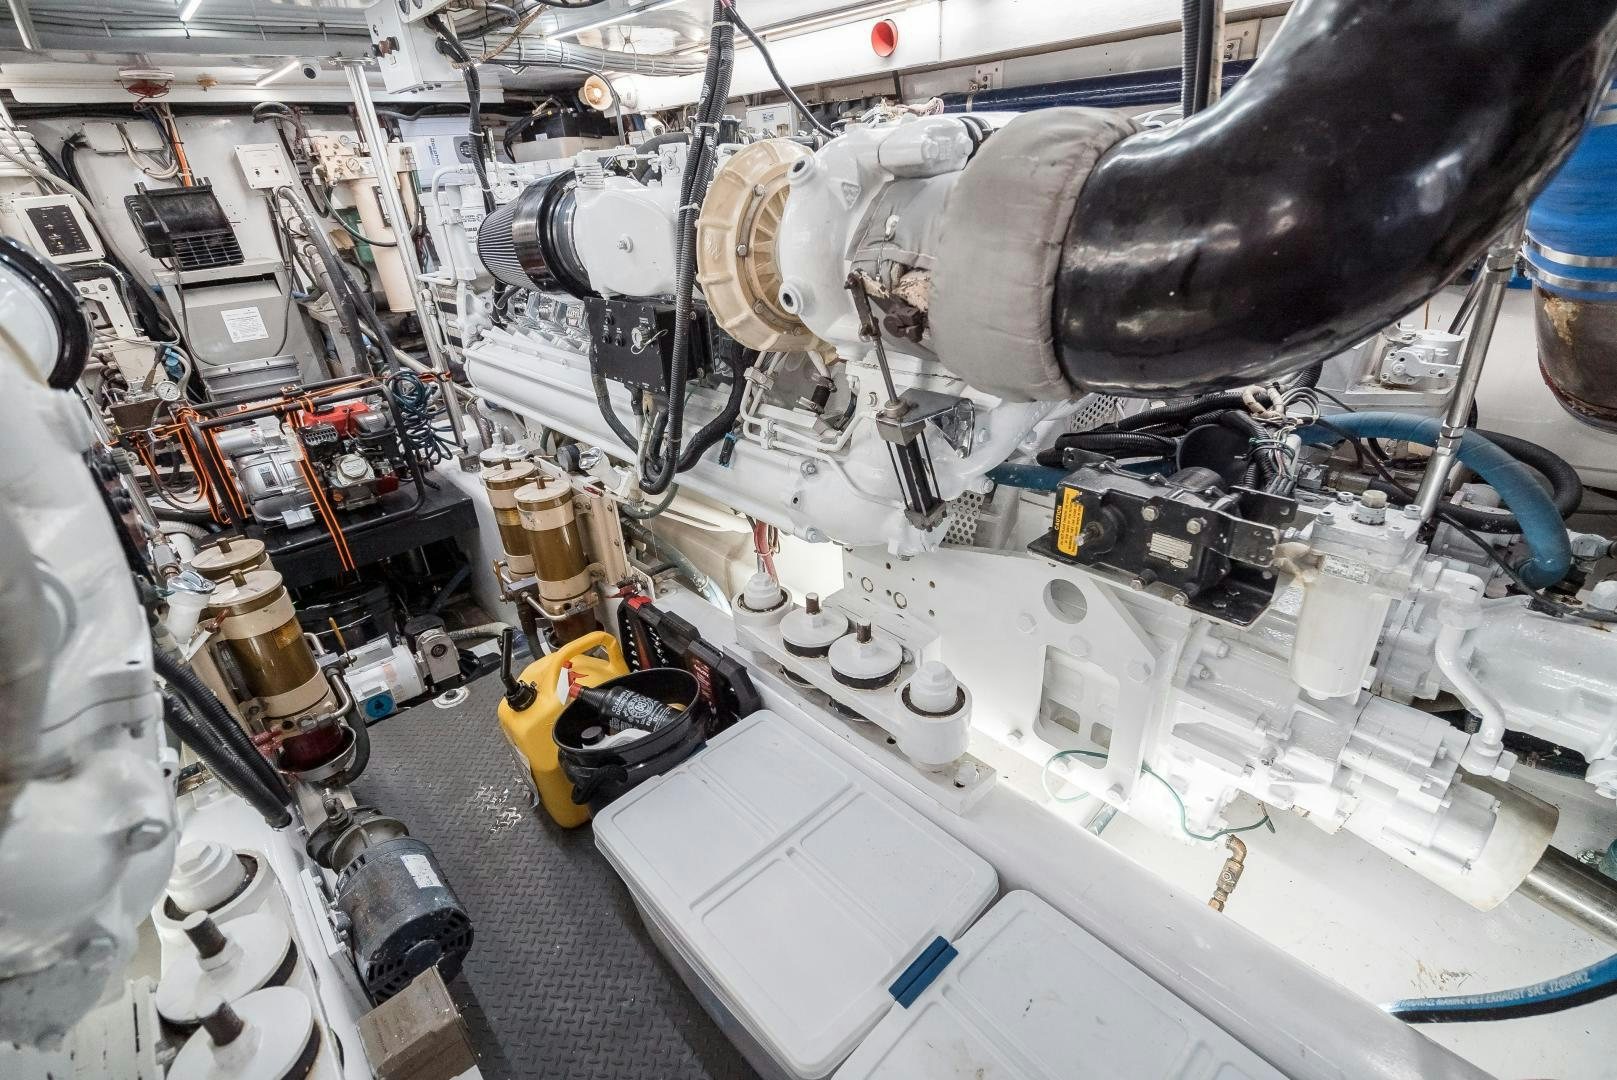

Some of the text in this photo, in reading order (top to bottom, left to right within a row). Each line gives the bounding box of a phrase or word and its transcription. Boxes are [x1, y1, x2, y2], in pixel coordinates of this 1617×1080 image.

[1054, 505, 1062, 530] CAUTION
[1486, 991, 1525, 1003] EXHAUST
[1527, 984, 1547, 998] SAE
